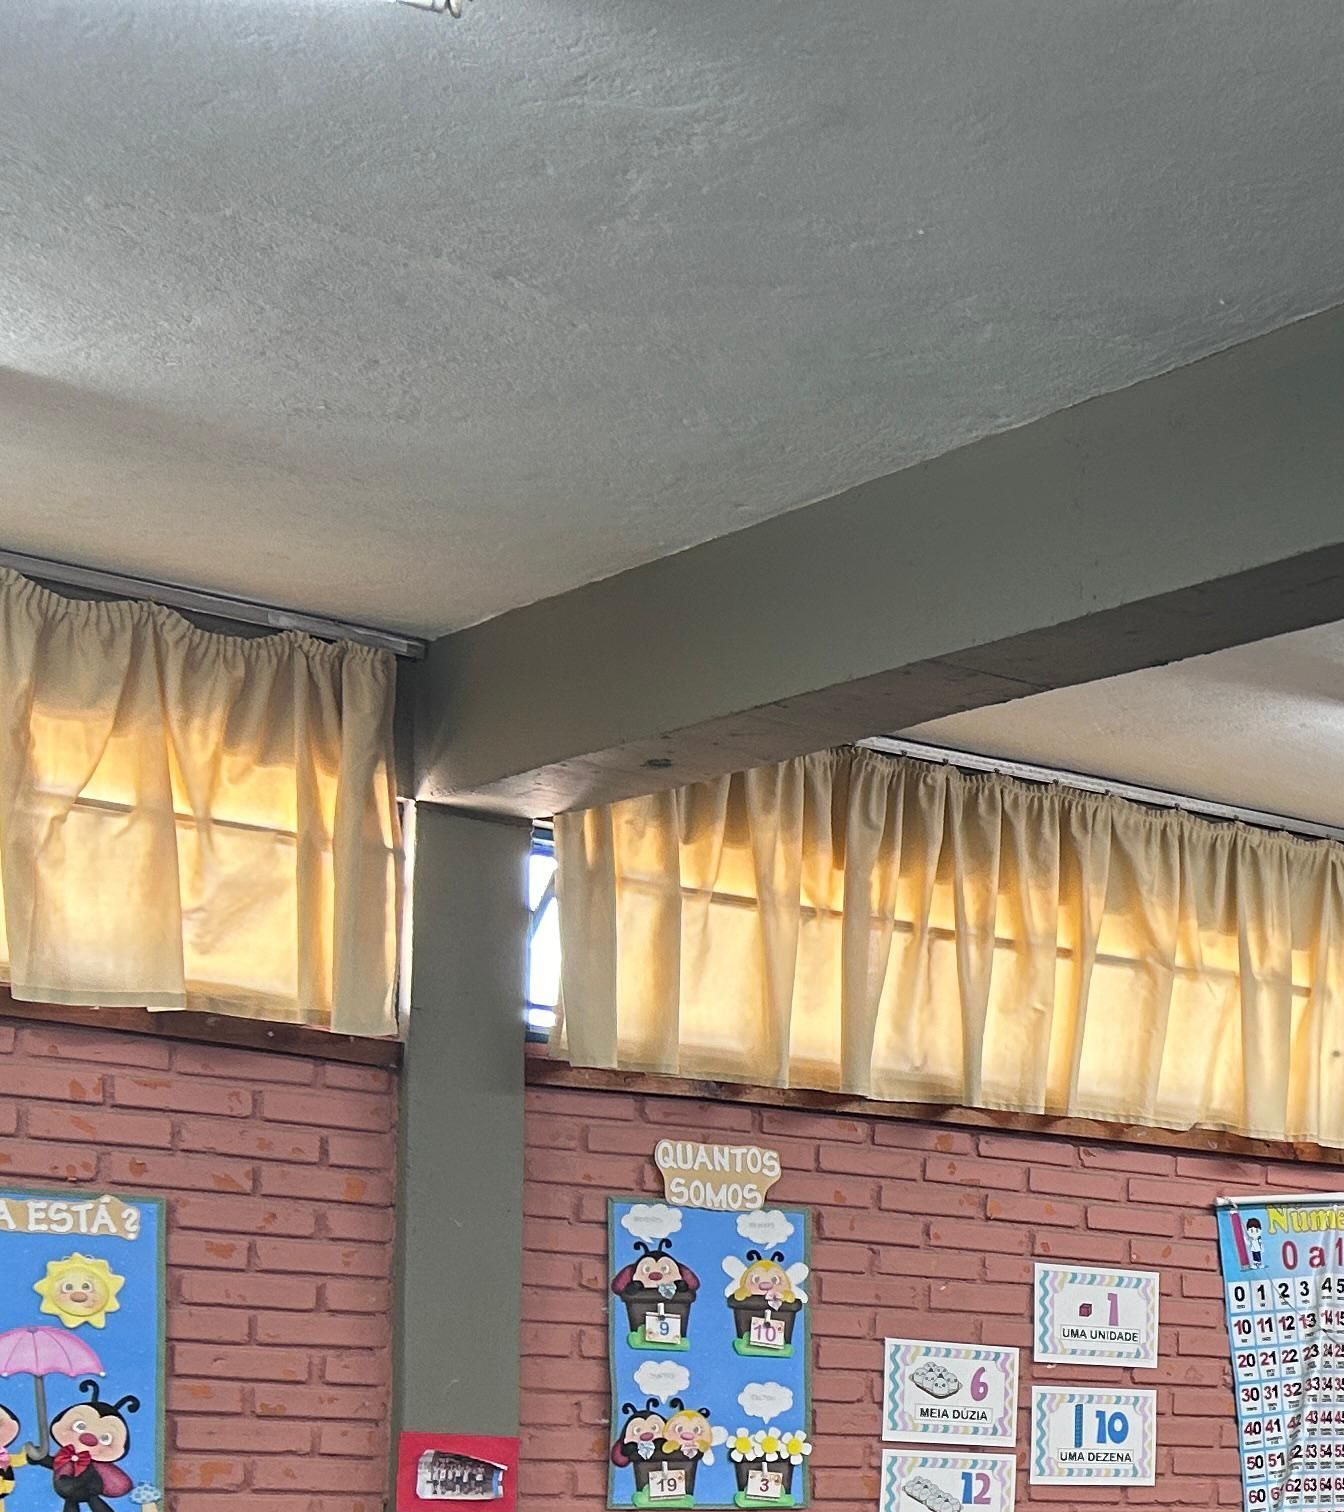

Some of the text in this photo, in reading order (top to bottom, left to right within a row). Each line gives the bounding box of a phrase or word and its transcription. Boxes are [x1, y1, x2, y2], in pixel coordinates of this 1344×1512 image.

[657, 1141, 780, 1177] QUANTOS
[670, 1177, 763, 1209] SOMOS
[1281, 1240, 1298, 1270] 0
[1309, 1245, 1325, 1269] a
[1234, 1286, 1245, 1302] 0
[1257, 1284, 1265, 1301] 1
[1300, 1281, 1310, 1296] 3
[1321, 1277, 1332, 1293] 4
[1107, 1292, 1119, 1326] 1
[659, 1321, 670, 1338] 9
[754, 1322, 777, 1342] 10
[1062, 1327, 1138, 1343] UMA UNIDADE
[1234, 1319, 1251, 1335] 10
[1257, 1317, 1273, 1333] 11
[1237, 1353, 1255, 1368] 20
[1260, 1351, 1277, 1366] 21
[970, 1366, 989, 1401] 6
[1241, 1387, 1259, 1402] 30
[1264, 1385, 1278, 1400] 31
[919, 1407, 988, 1421] MEIA DÚZIA
[1095, 1410, 1129, 1444] 10
[1244, 1421, 1261, 1435] 40
[1265, 1418, 1281, 1433] 41
[1060, 1451, 1132, 1463] UMA DEZENA
[1247, 1455, 1264, 1470] 50
[1268, 1452, 1285, 1467] 51
[656, 1477, 678, 1493] 19
[759, 1477, 770, 1493] 3
[961, 1472, 991, 1504] 12
[1249, 1489, 1266, 1504] 60
